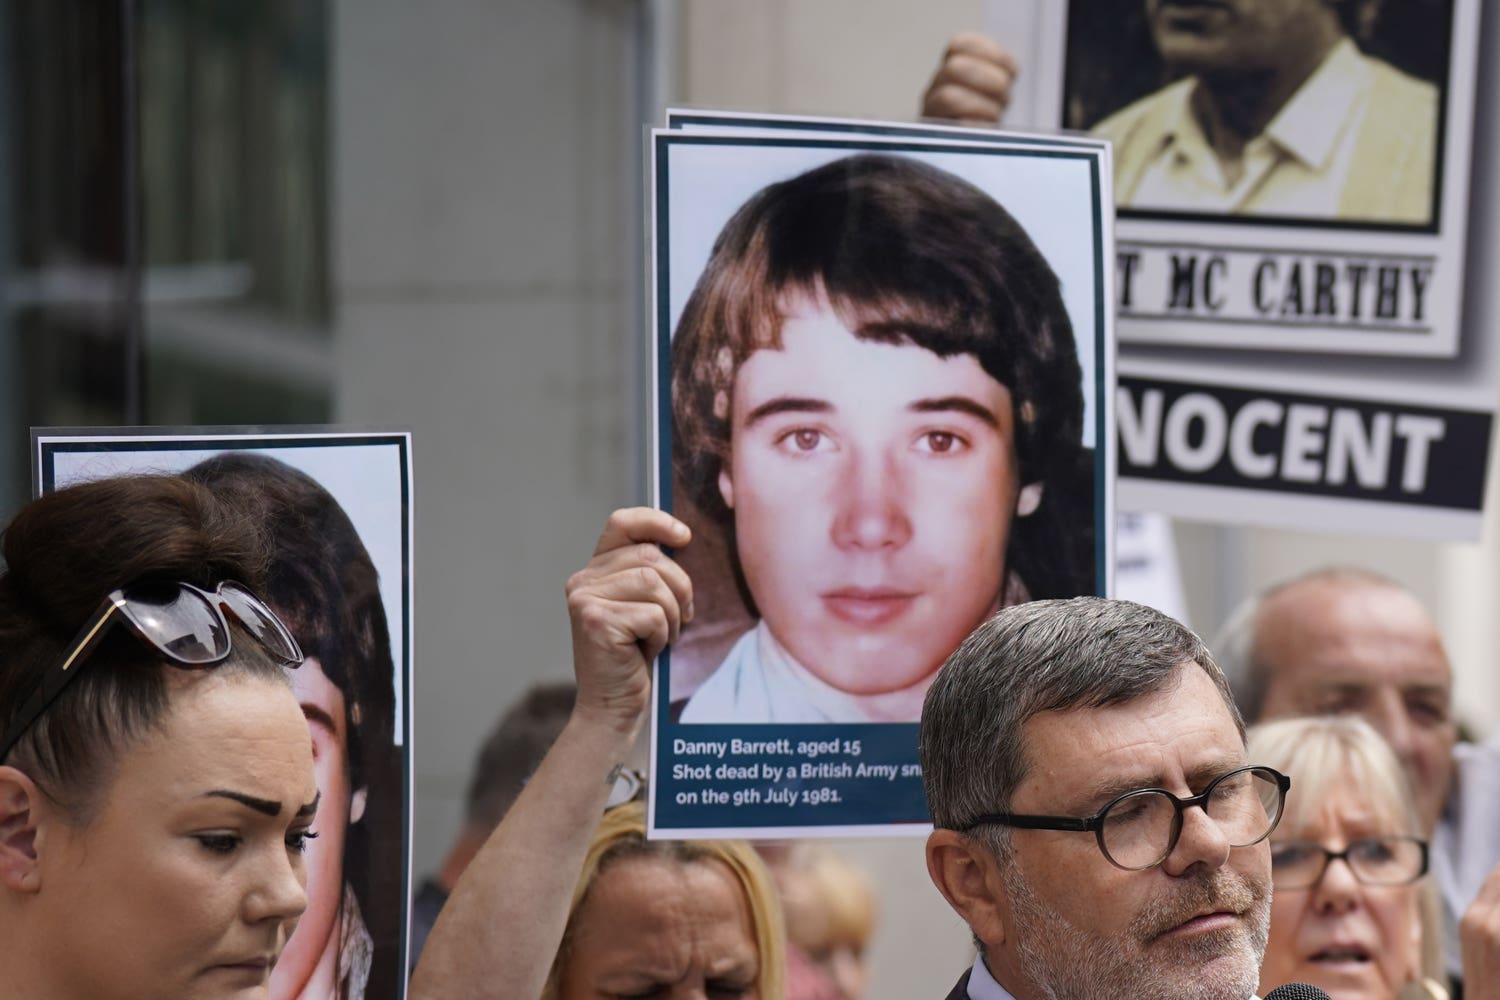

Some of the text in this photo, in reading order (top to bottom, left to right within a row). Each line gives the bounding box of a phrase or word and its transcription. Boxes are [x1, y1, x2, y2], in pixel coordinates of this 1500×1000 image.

[1168, 254, 1229, 312] MC
[1252, 258, 1434, 322] CARTHY
[673, 737, 861, 759] Danny Barrett, aged 15
[672, 763, 712, 780] Shot
[715, 762, 759, 780] dead
[762, 762, 782, 783] by
[786, 766, 797, 779] a
[800, 762, 852, 779] British
[855, 762, 898, 781] Army
[676, 788, 842, 807] on the 9th July 1981.
